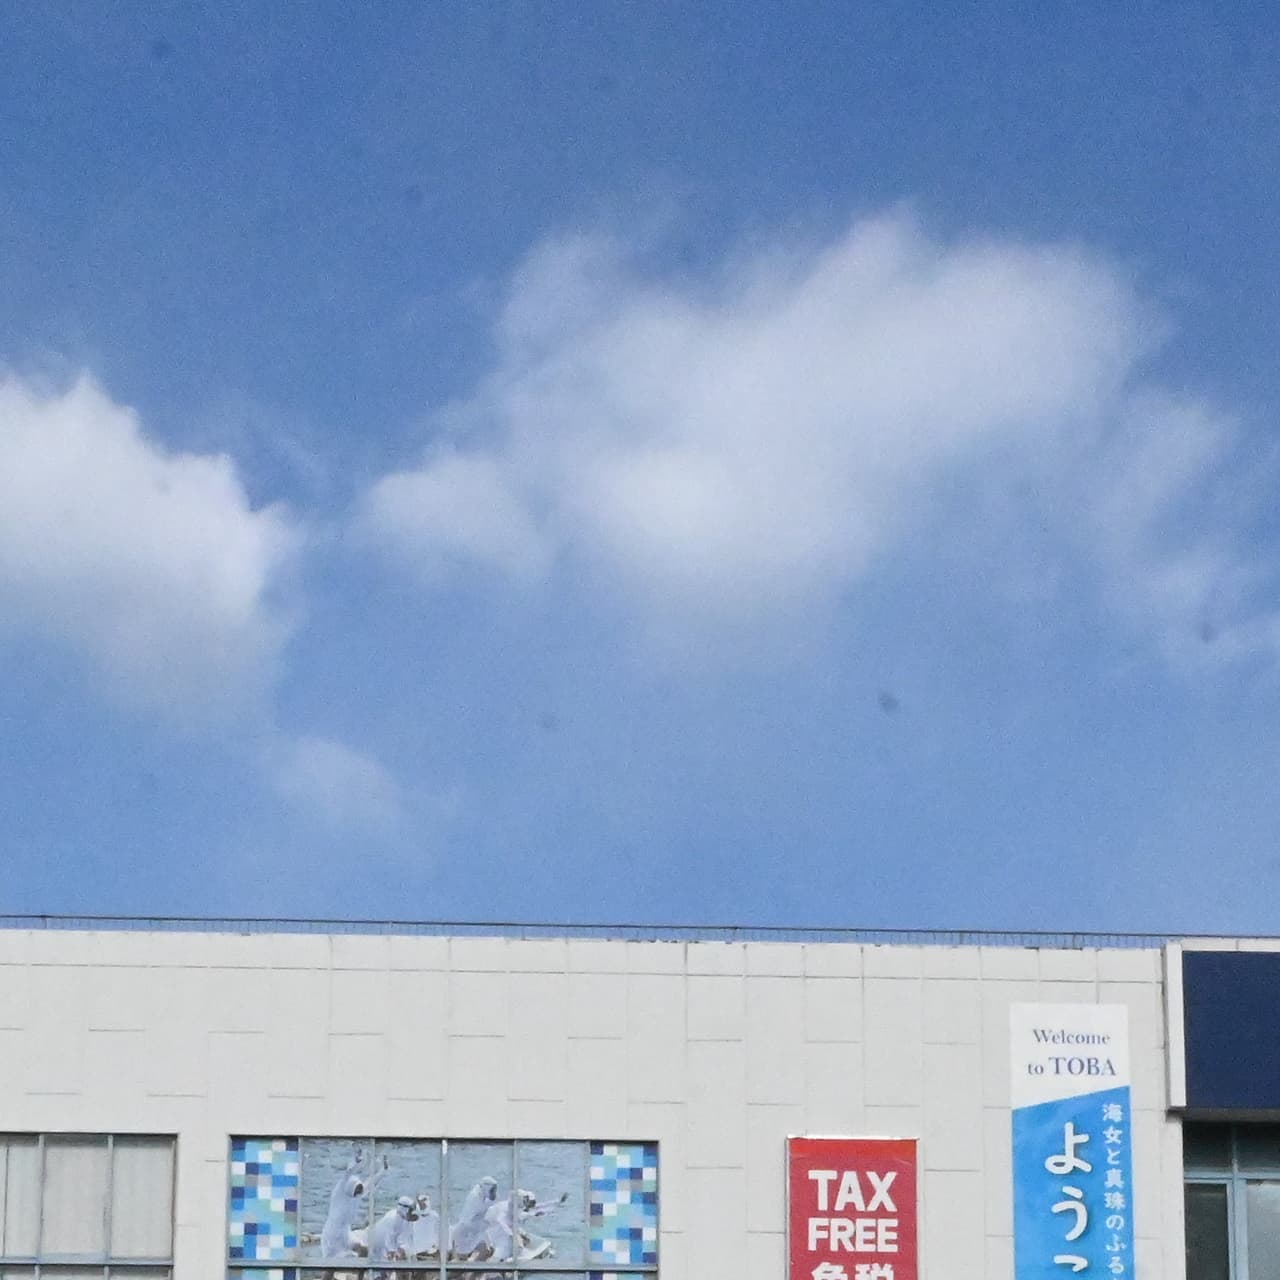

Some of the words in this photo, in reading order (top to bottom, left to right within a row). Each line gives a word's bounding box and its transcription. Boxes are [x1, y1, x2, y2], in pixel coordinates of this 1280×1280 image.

[1032, 1028, 1111, 1046] Welcome
[1027, 1062, 1044, 1077] to
[1049, 1056, 1118, 1077] TOBA
[808, 1169, 898, 1212] TAX
[807, 1217, 899, 1253] FREE
